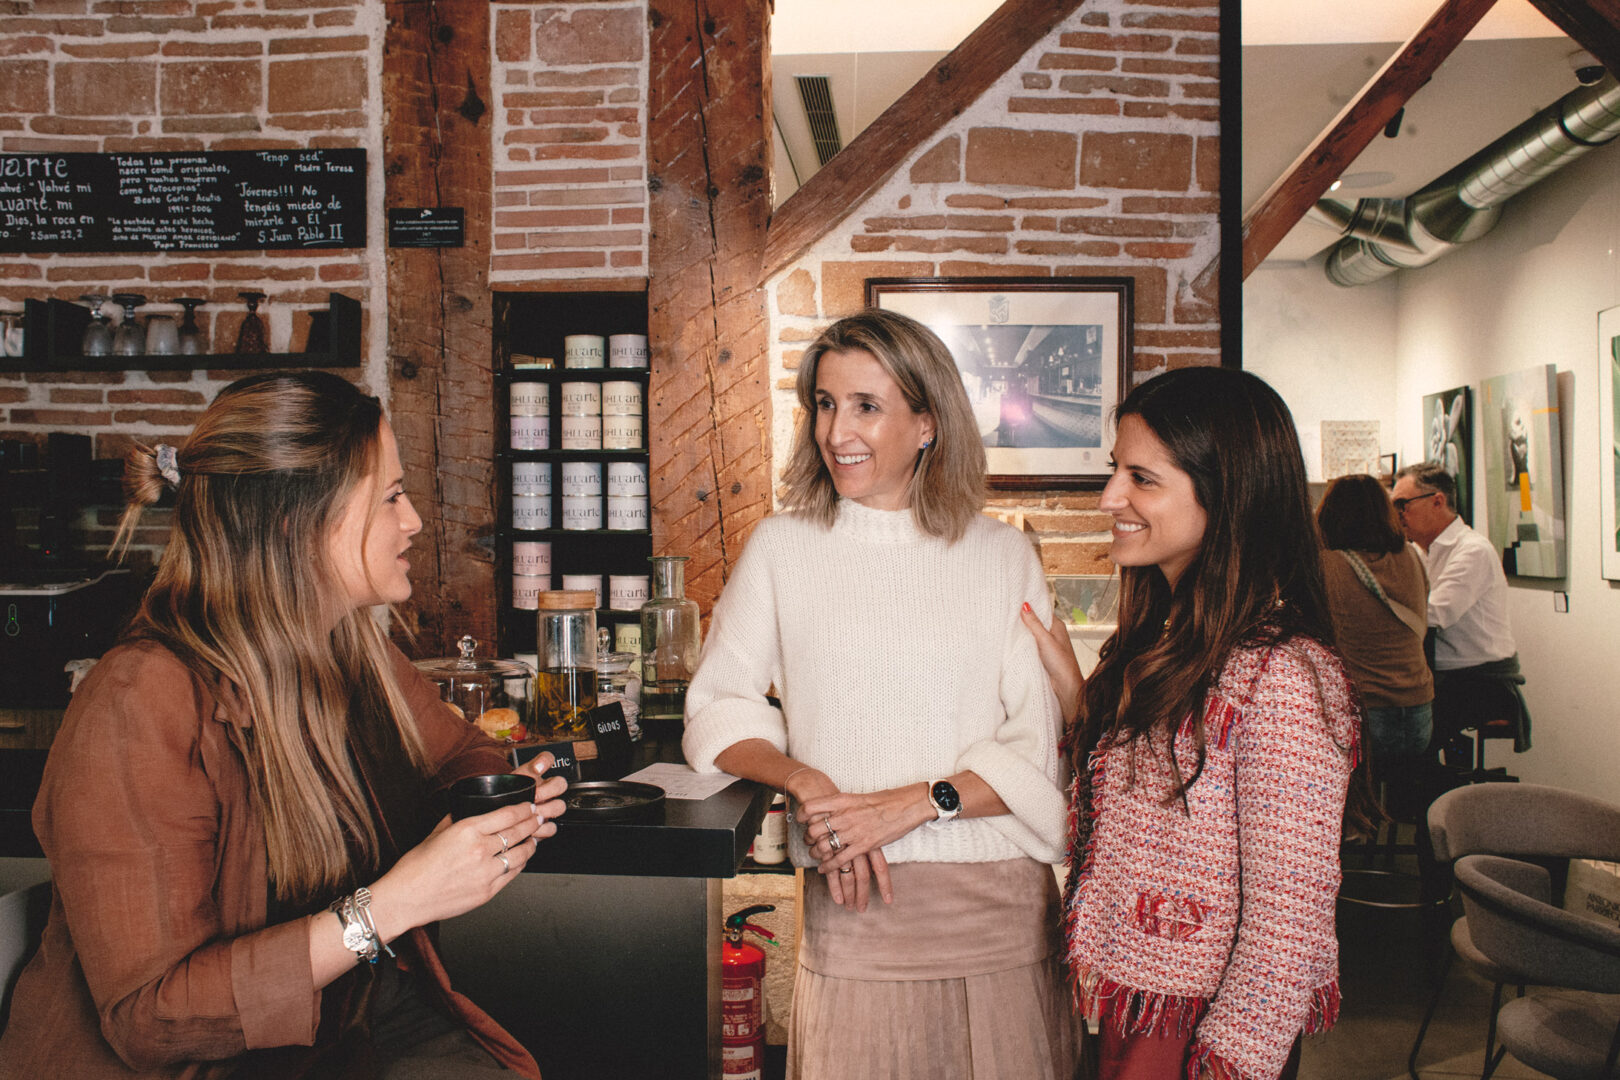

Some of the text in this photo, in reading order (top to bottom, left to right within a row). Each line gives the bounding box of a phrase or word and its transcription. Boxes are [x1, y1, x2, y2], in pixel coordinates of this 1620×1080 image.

[149, 156, 164, 165] las
[168, 156, 207, 168] personas
[294, 161, 354, 173] Madre Teresa
[119, 167, 147, 175] nacen
[119, 175, 217, 188] pero muchos mueren
[76, 183, 92, 193] mi
[119, 187, 143, 196] como
[301, 185, 318, 196] No
[56, 199, 73, 210] mi
[133, 193, 222, 205] Beato Carlo Acutis
[244, 194, 342, 217] tengáis miedo de
[35, 213, 48, 225] la
[52, 216, 76, 225] roca
[79, 215, 94, 225] en
[123, 217, 155, 225] santidad
[192, 217, 214, 226] hecha
[244, 215, 284, 227] mirarle
[291, 216, 298, 224] a
[269, 229, 293, 242] Juan
[297, 226, 325, 240] Pablo
[329, 223, 344, 240] II
[153, 240, 219, 250] Papa Francisco
